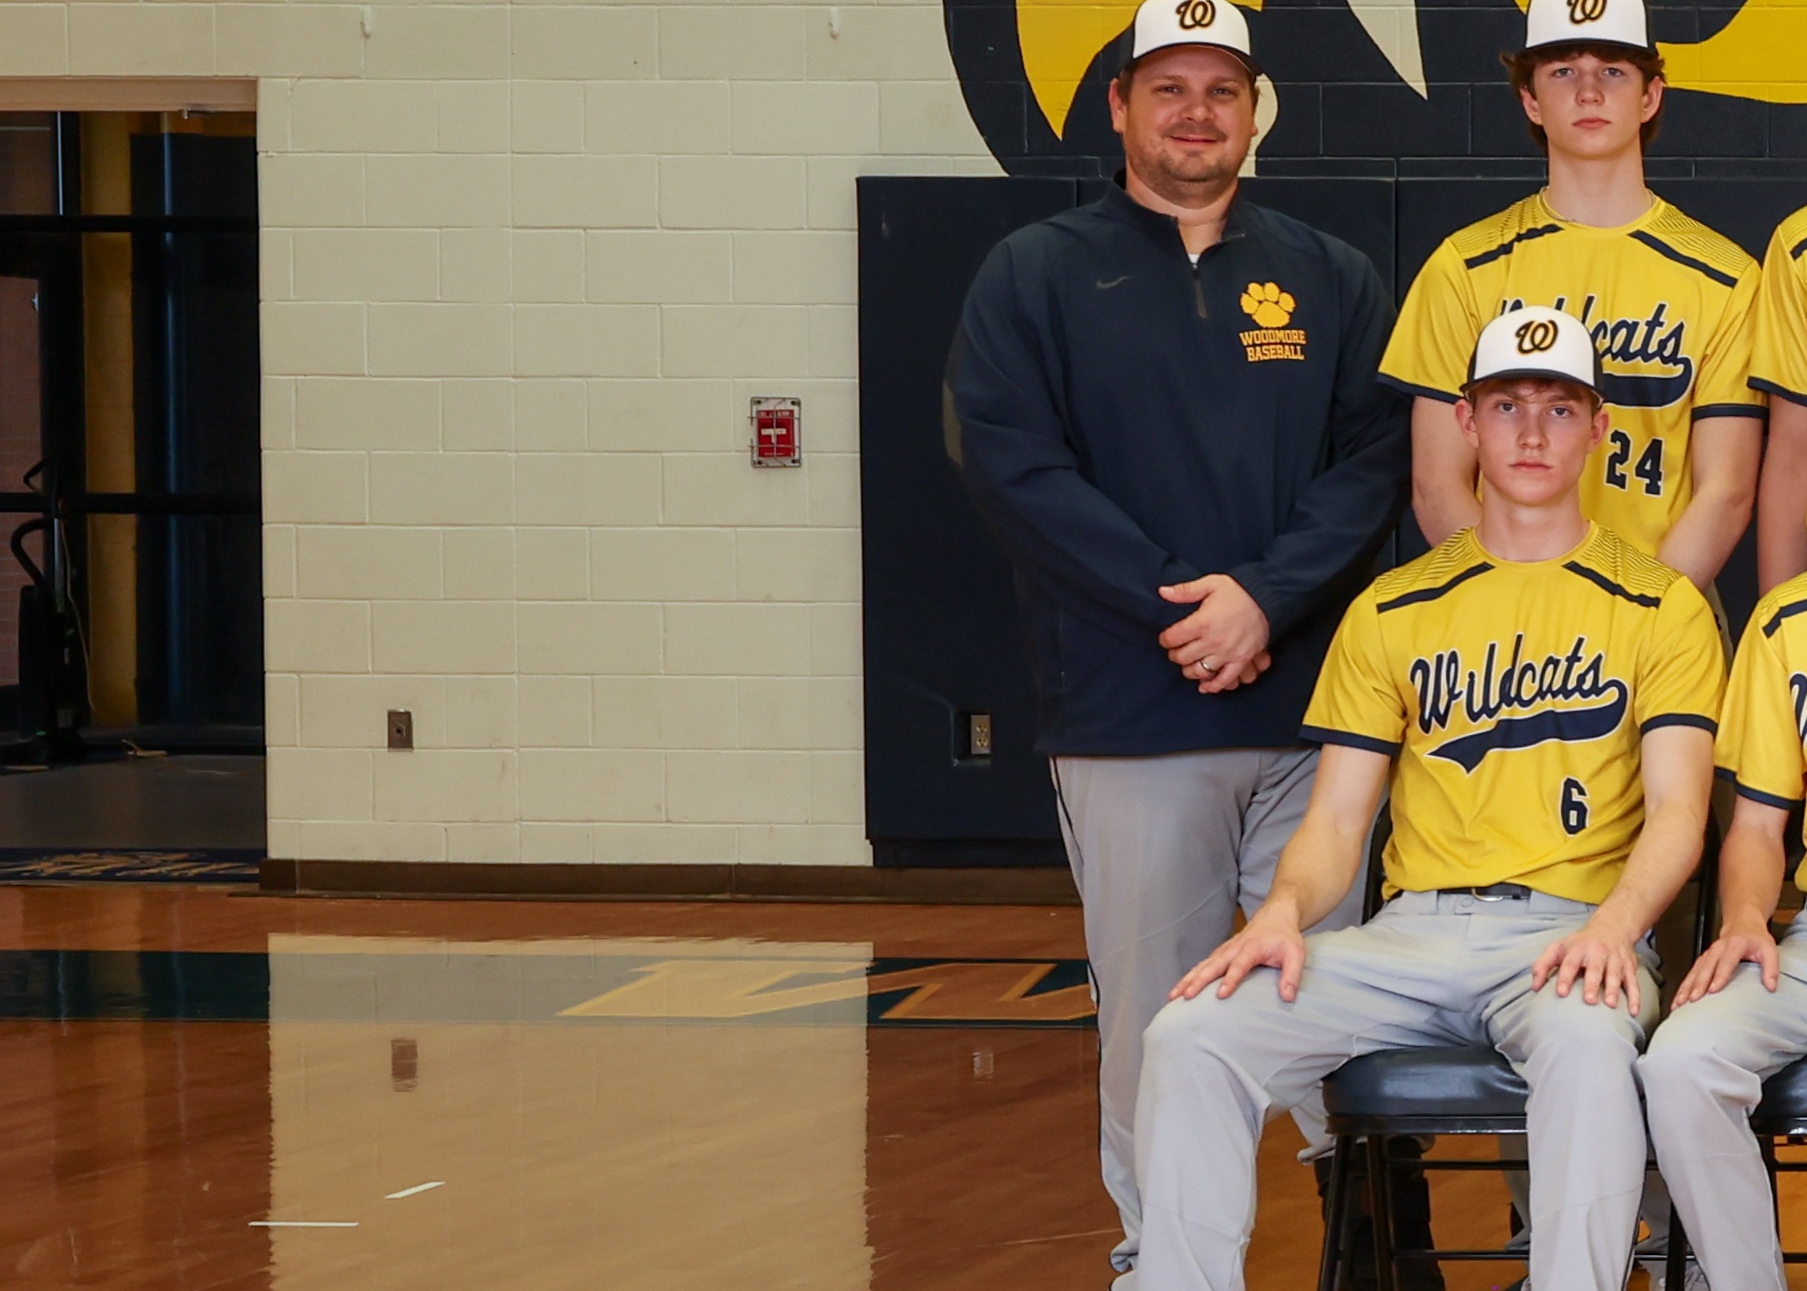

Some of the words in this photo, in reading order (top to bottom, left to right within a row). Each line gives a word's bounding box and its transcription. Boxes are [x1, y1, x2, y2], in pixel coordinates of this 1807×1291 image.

[1239, 329, 1307, 346] WOODMORE
[1247, 344, 1305, 362] BASEBALL
[1605, 429, 1664, 496] 24
[1410, 634, 1604, 734] Wildcats
[1560, 776, 1588, 836] 6
